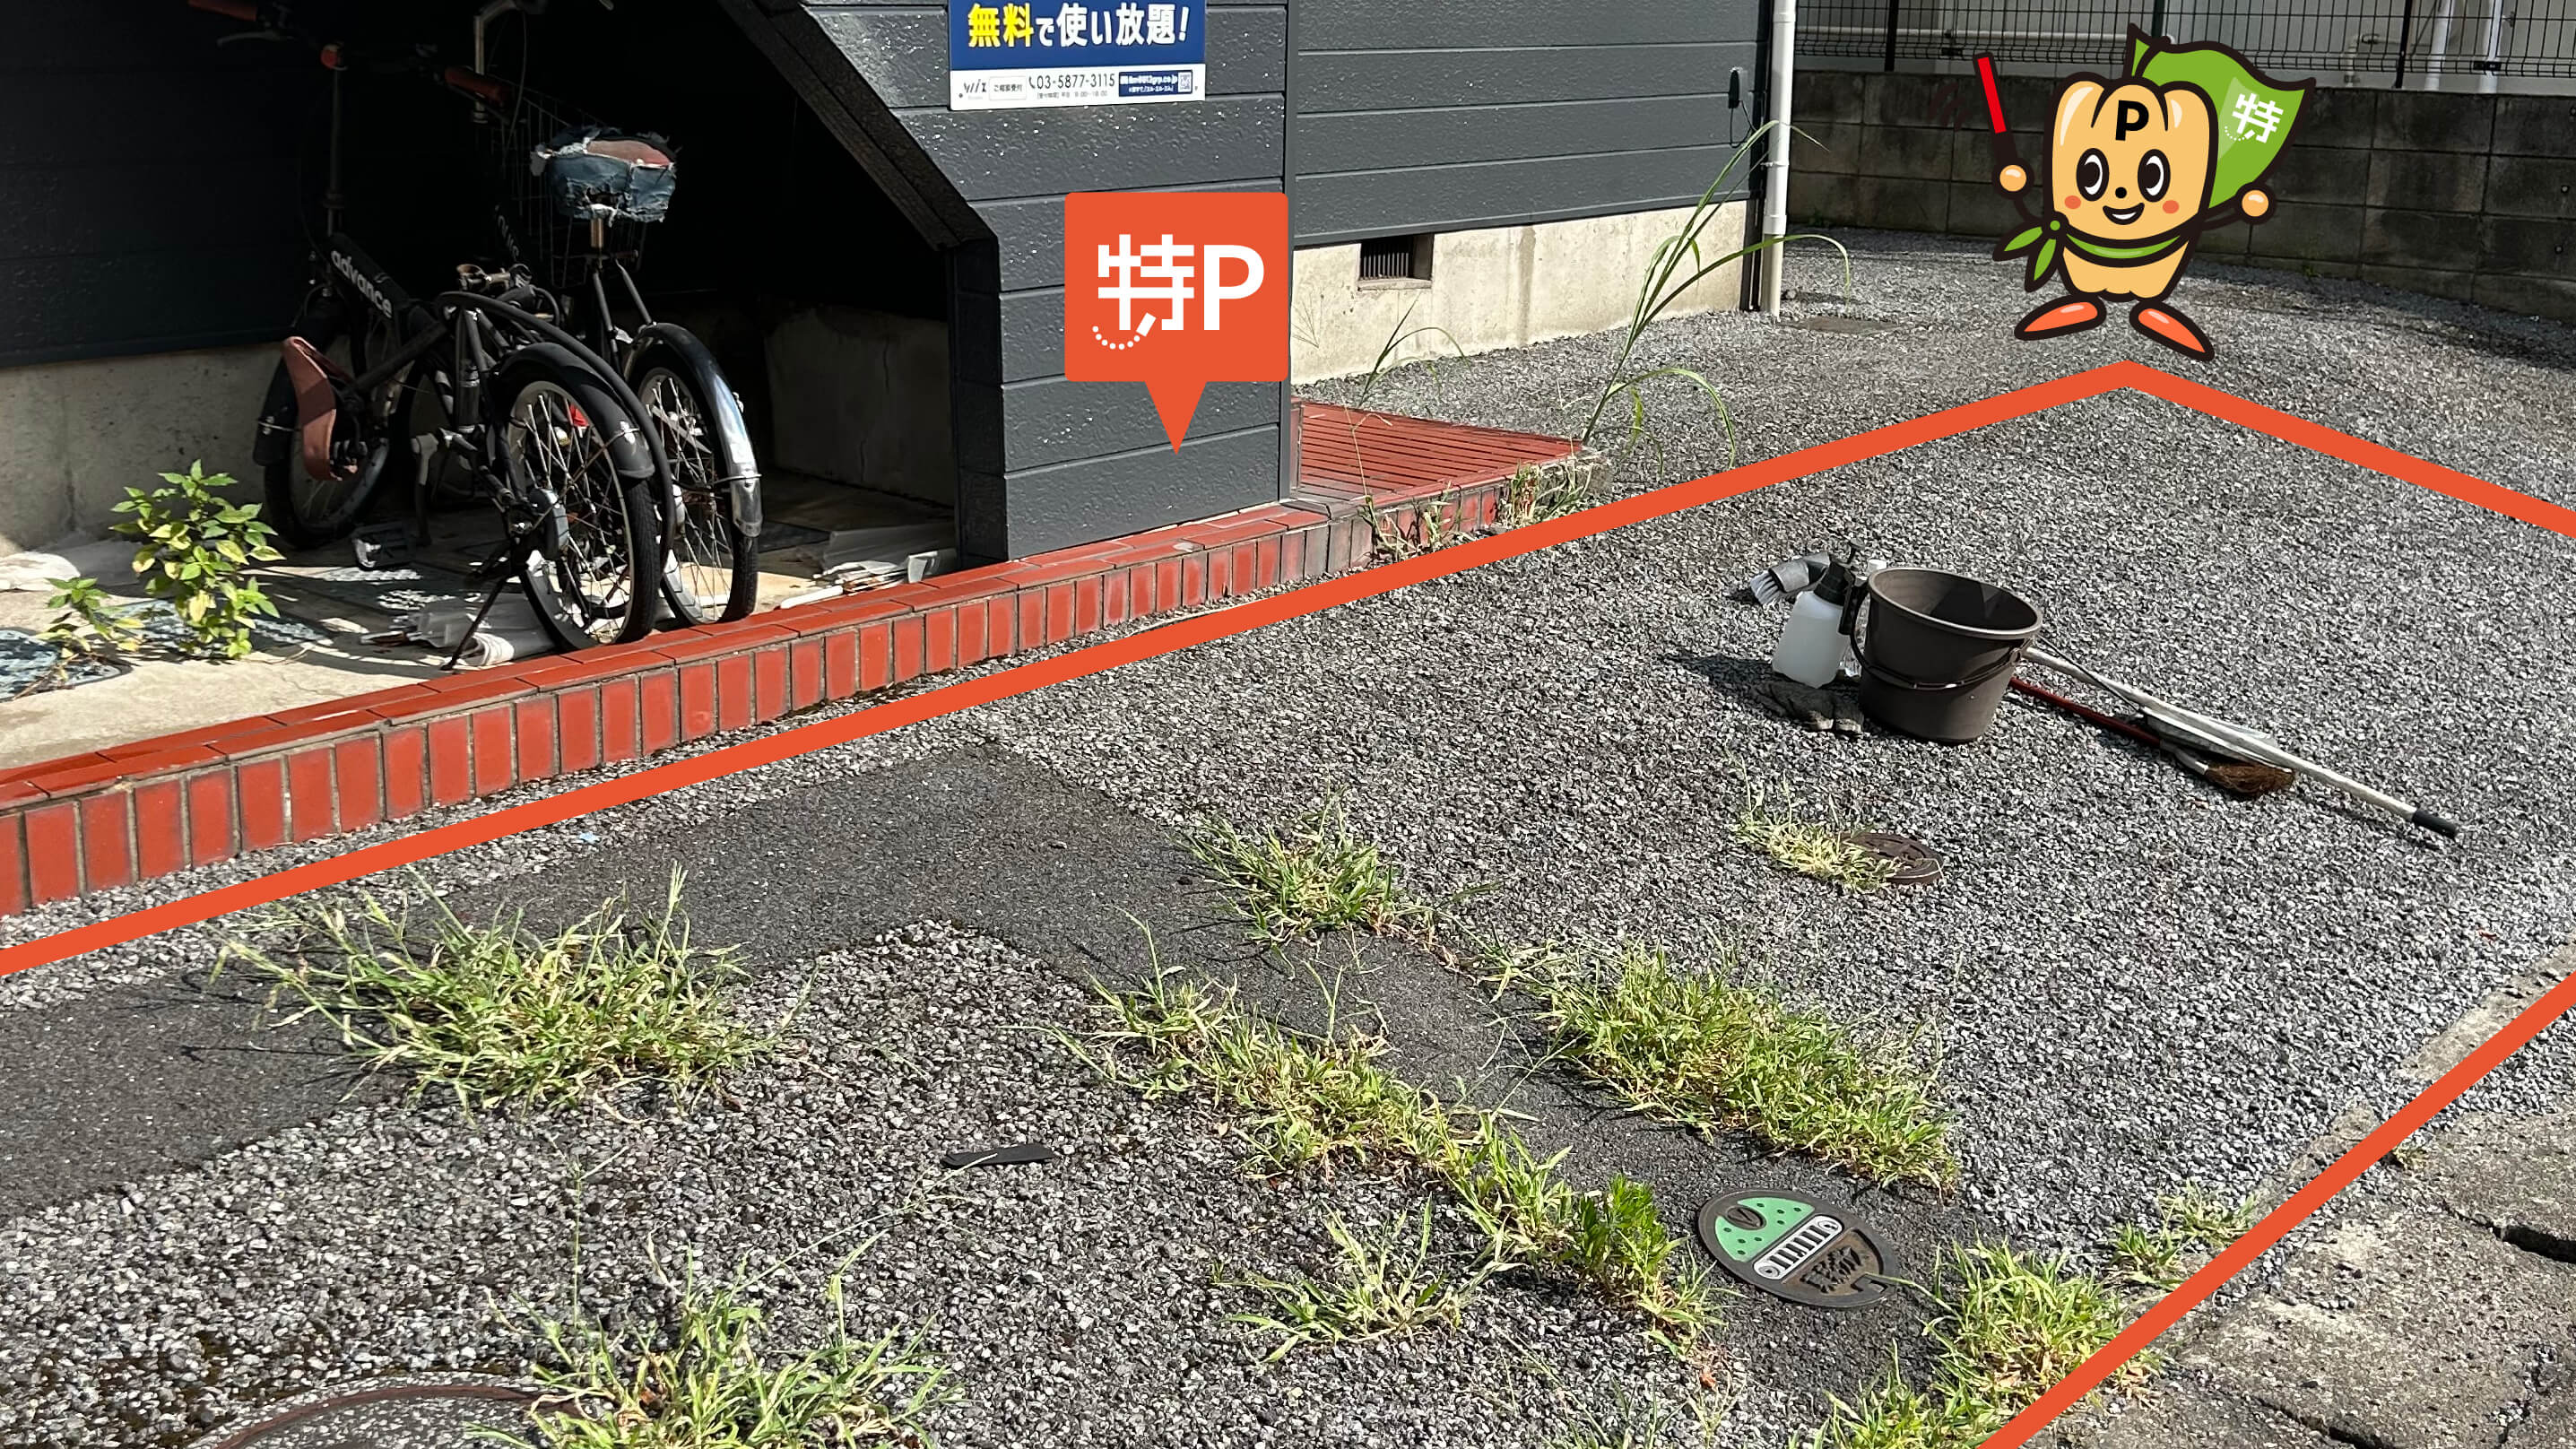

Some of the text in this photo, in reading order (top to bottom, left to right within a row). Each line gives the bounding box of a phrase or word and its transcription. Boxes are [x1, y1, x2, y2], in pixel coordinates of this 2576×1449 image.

[968, 3, 1190, 48] 無料で使い放題!
[1036, 73, 1115, 90] 03-5877-3115
[330, 248, 393, 317] advance
